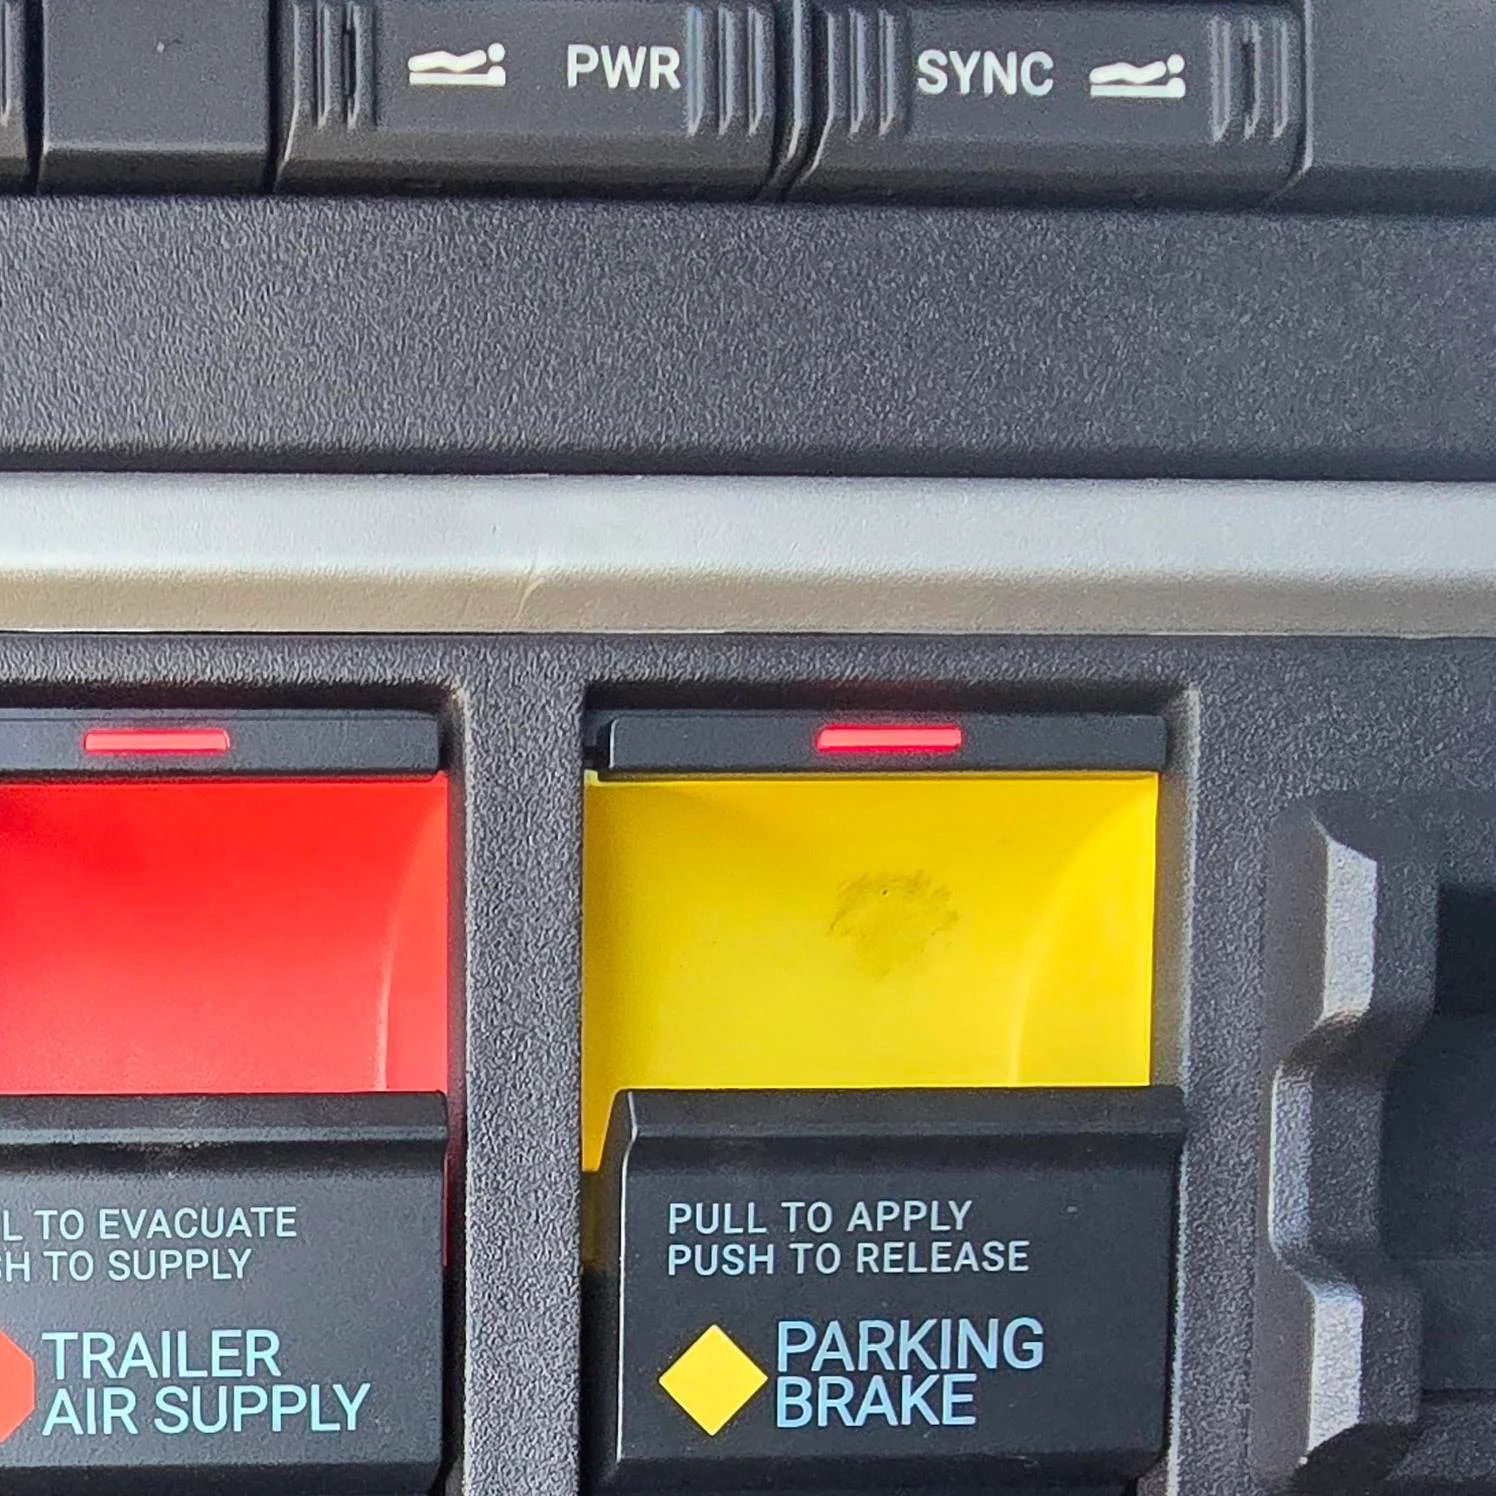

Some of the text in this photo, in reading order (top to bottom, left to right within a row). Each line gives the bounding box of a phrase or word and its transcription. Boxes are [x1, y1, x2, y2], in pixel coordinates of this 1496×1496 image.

[566, 44, 682, 90] PWR
[916, 49, 1055, 98] SYNC
[35, 1207, 85, 1241] TO
[98, 1206, 297, 1240] EVACUATE
[668, 1199, 973, 1235] PULL TO APPLY
[44, 1250, 95, 1281] TO
[107, 1248, 253, 1281] SUPPLY
[668, 1240, 1030, 1276] PUSH TO RELEASE
[41, 1328, 282, 1380] TRAILER
[776, 1316, 1045, 1373] PARKING
[41, 1382, 371, 1437] AIR SUPPLY
[776, 1373, 978, 1429] BRAKE
